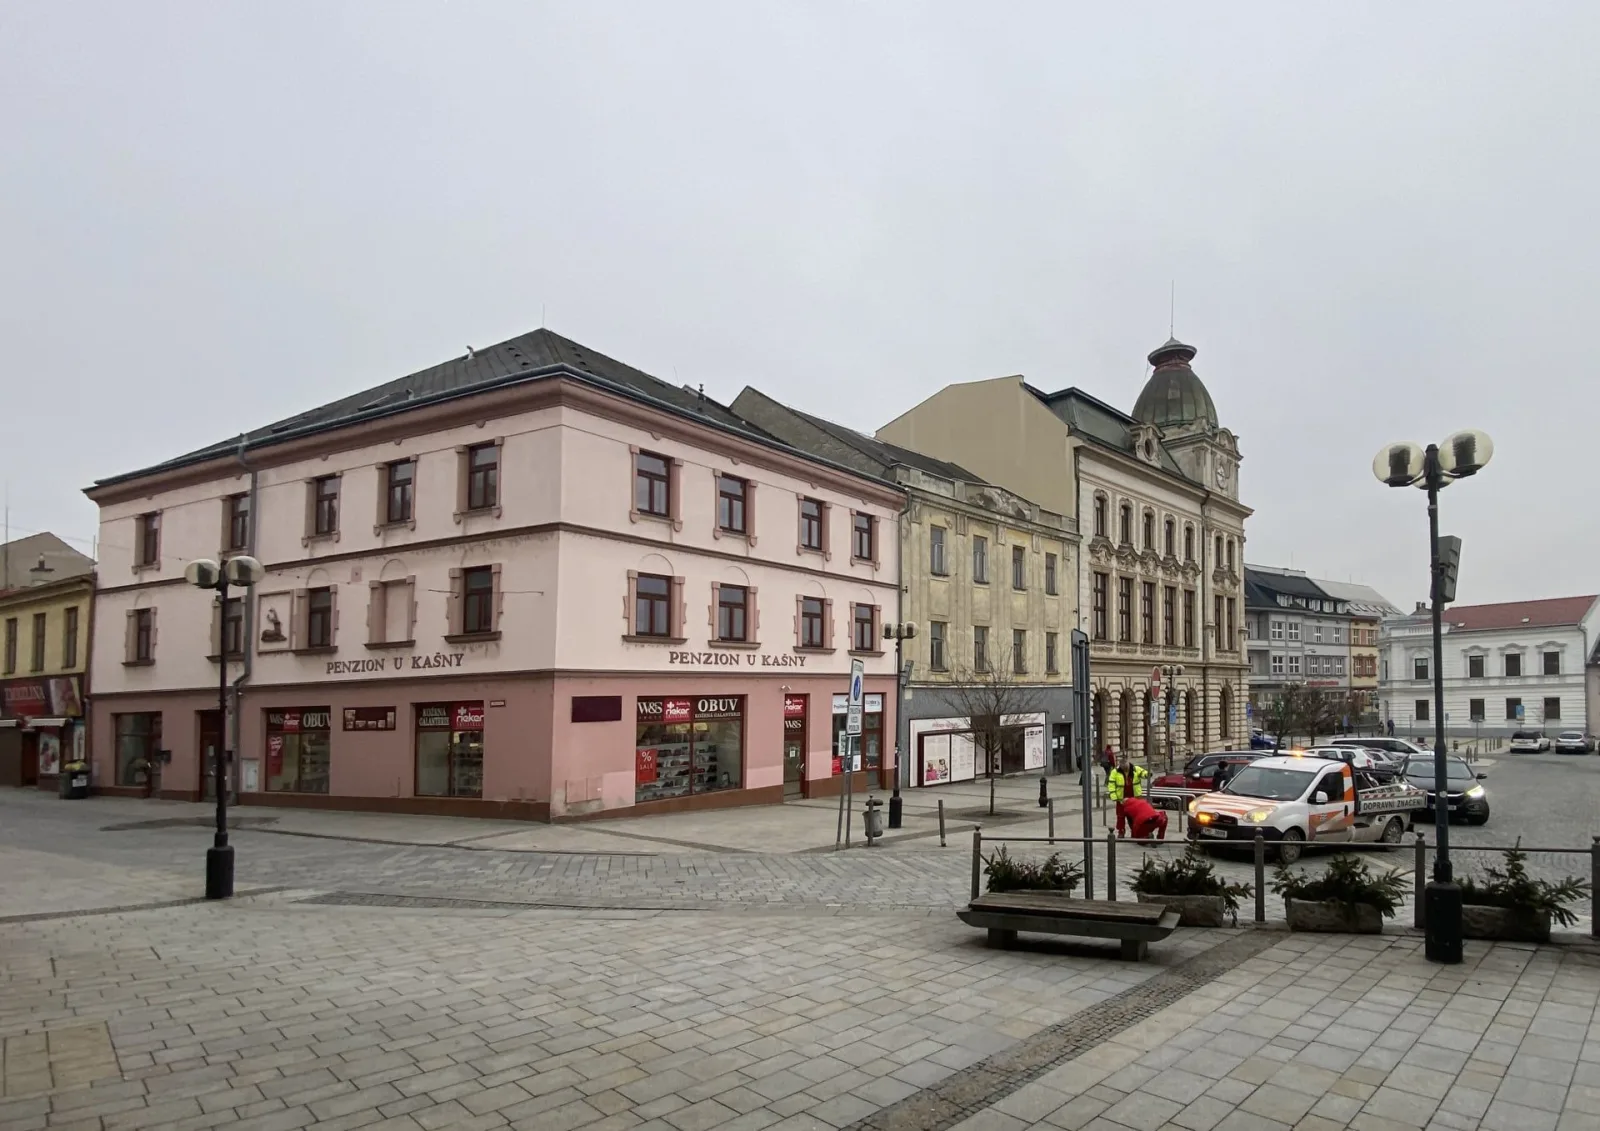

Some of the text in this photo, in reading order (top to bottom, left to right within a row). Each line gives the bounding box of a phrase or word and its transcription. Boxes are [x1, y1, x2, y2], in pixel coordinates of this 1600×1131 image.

[326, 652, 464, 674] PENZION U KAŠNY
[669, 651, 806, 667] PENZION U KAŠNY
[638, 702, 663, 714] W&S
[698, 698, 739, 713] OBUV
[456, 712, 484, 723] rieker
[641, 750, 652, 762] %
